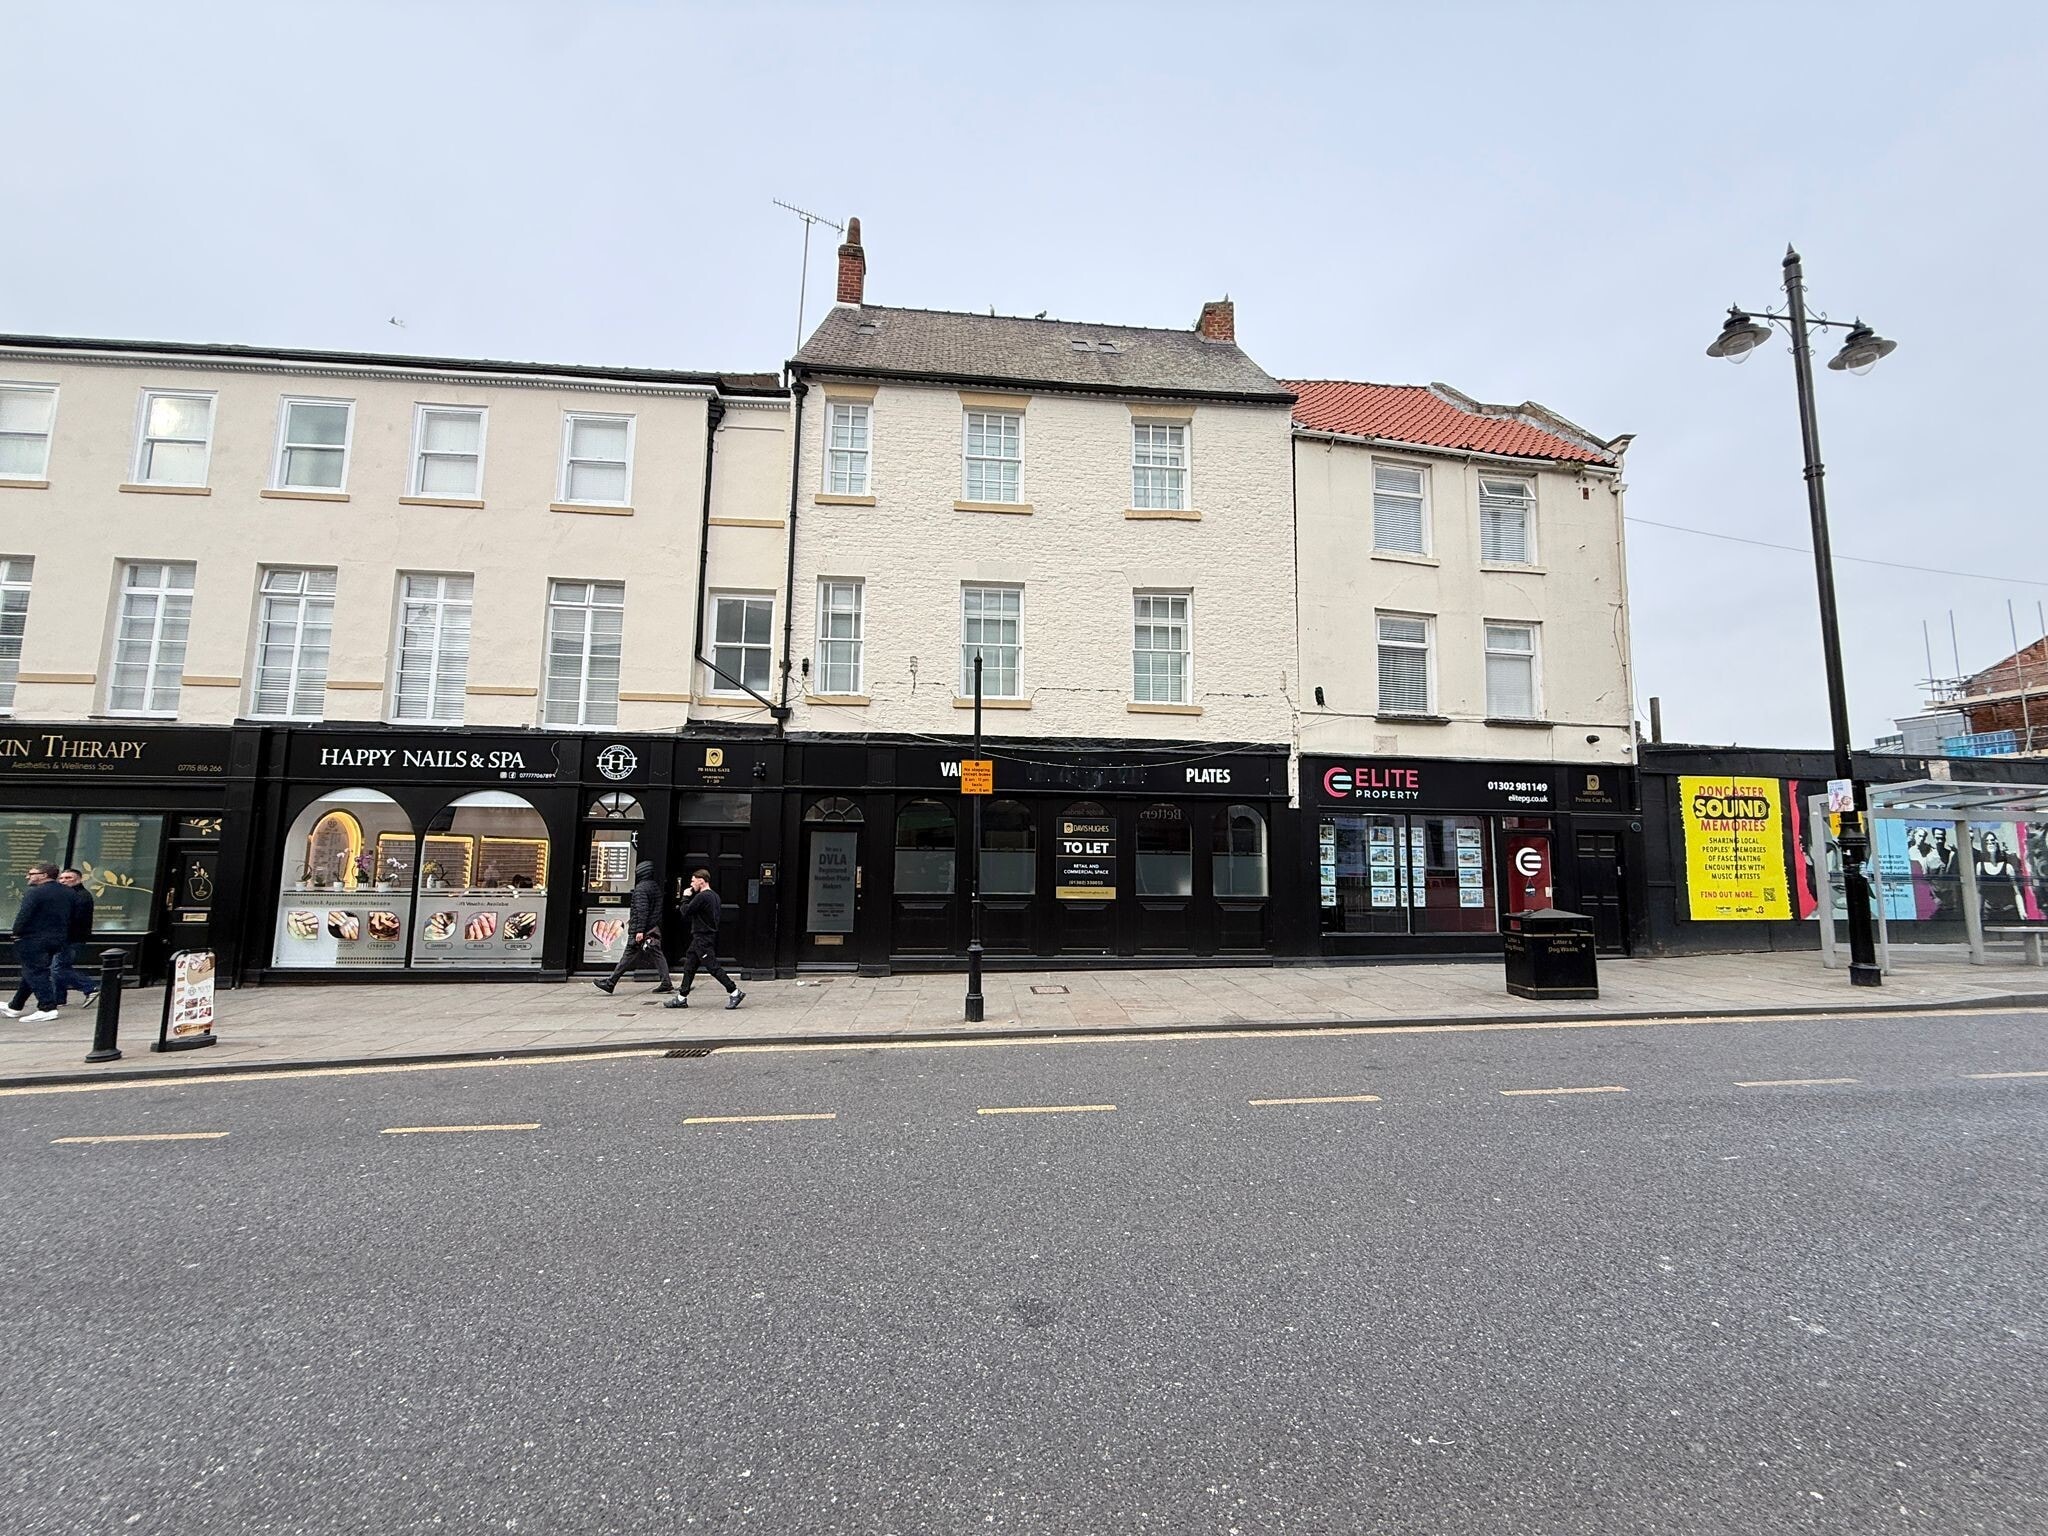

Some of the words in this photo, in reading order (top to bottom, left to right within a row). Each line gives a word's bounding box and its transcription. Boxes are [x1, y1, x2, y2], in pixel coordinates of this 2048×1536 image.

[320, 748, 396, 767] HAPPY
[403, 750, 467, 768] NAILS
[470, 753, 484, 768] &
[488, 751, 526, 769] SPA
[12, 761, 51, 769] Aesthetics
[62, 762, 96, 770] Wellness
[98, 763, 114, 771] Spa
[1186, 768, 1231, 784] PLATES
[1355, 768, 1419, 788] ELITE
[1487, 781, 1514, 791] 01302
[1515, 781, 1548, 792] 981149
[1698, 785, 1764, 797] DONCASTER
[1355, 789, 1419, 800] PROPERTY
[1508, 793, 1548, 804] elitepg.co.uk
[1694, 799, 1767, 818] SOUND
[1700, 820, 1766, 832] MEMORIES
[1063, 841, 1083, 853] TO
[1086, 842, 1109, 854] LET
[819, 853, 847, 866] DVLA
[1548, 946, 1560, 954] Dog
